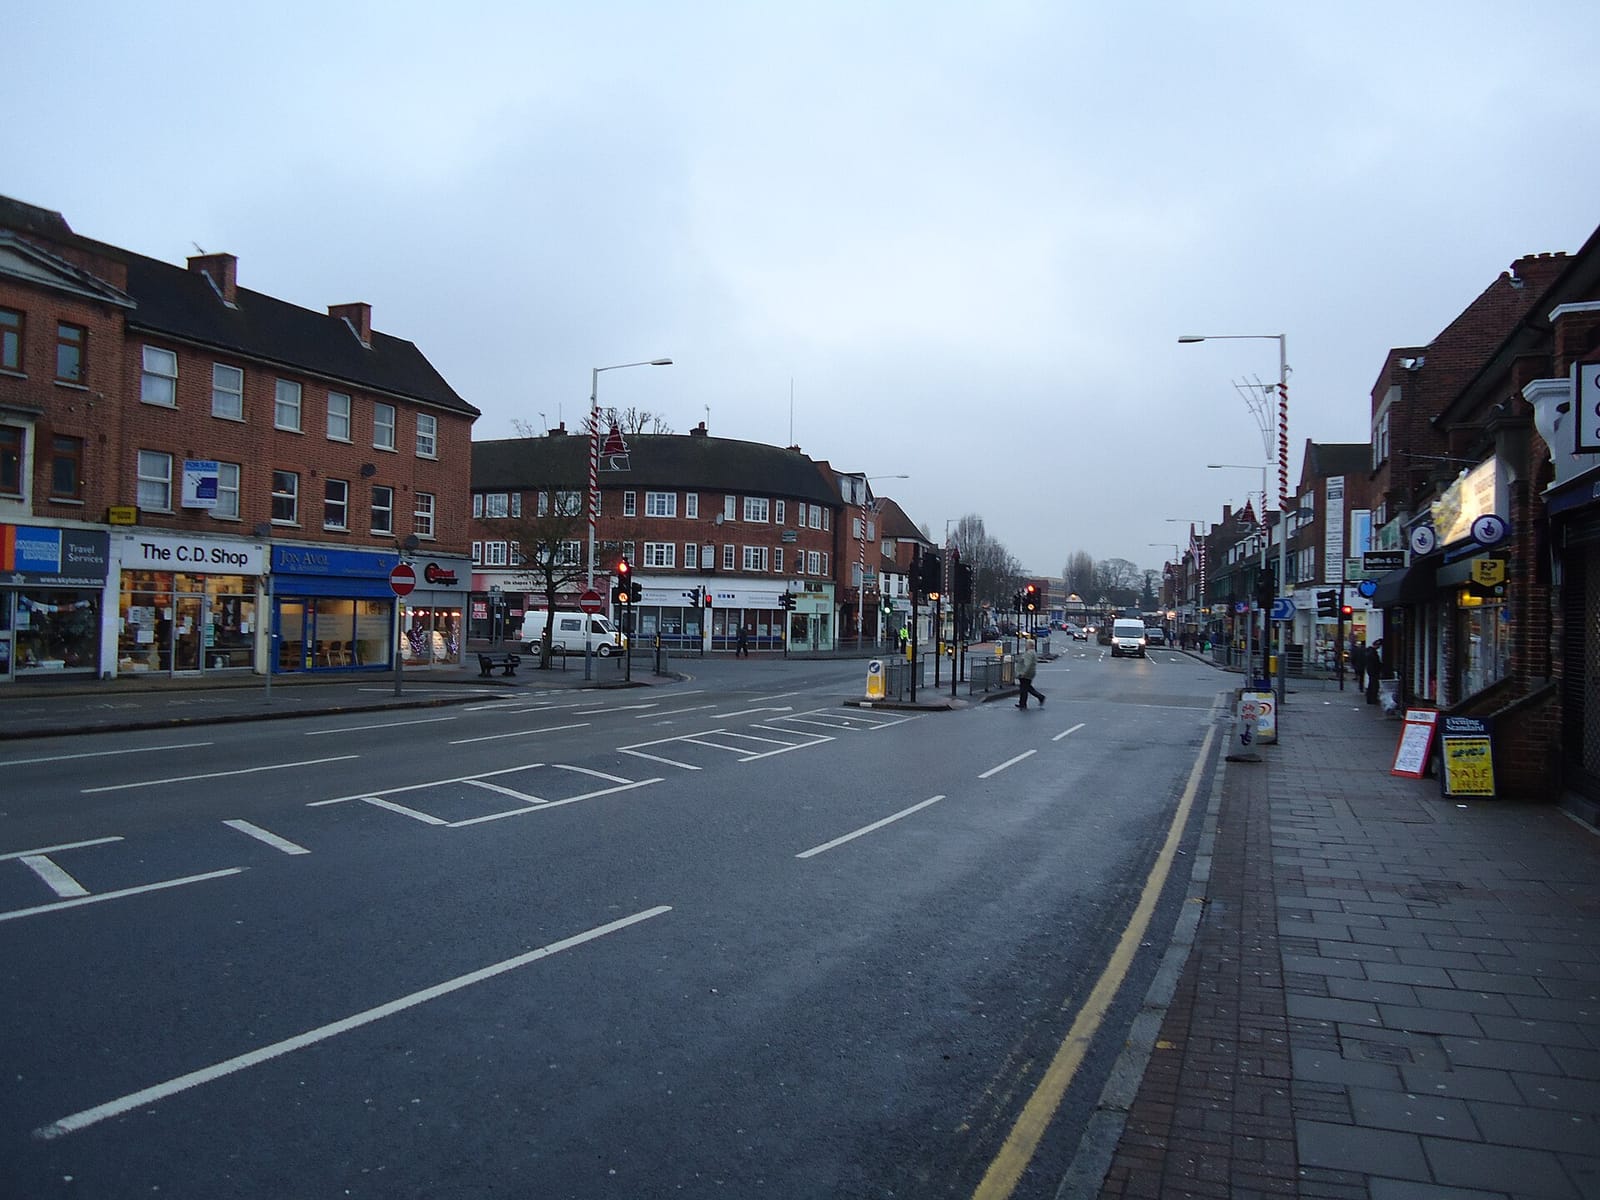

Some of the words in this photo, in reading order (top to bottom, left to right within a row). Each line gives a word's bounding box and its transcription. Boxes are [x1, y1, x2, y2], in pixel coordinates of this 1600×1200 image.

[69, 544, 95, 553] Travel
[68, 553, 104, 563] Services
[141, 543, 171, 560] The
[177, 546, 208, 563] C.D.
[211, 549, 248, 567] Shop
[1451, 769, 1489, 778] SALE
